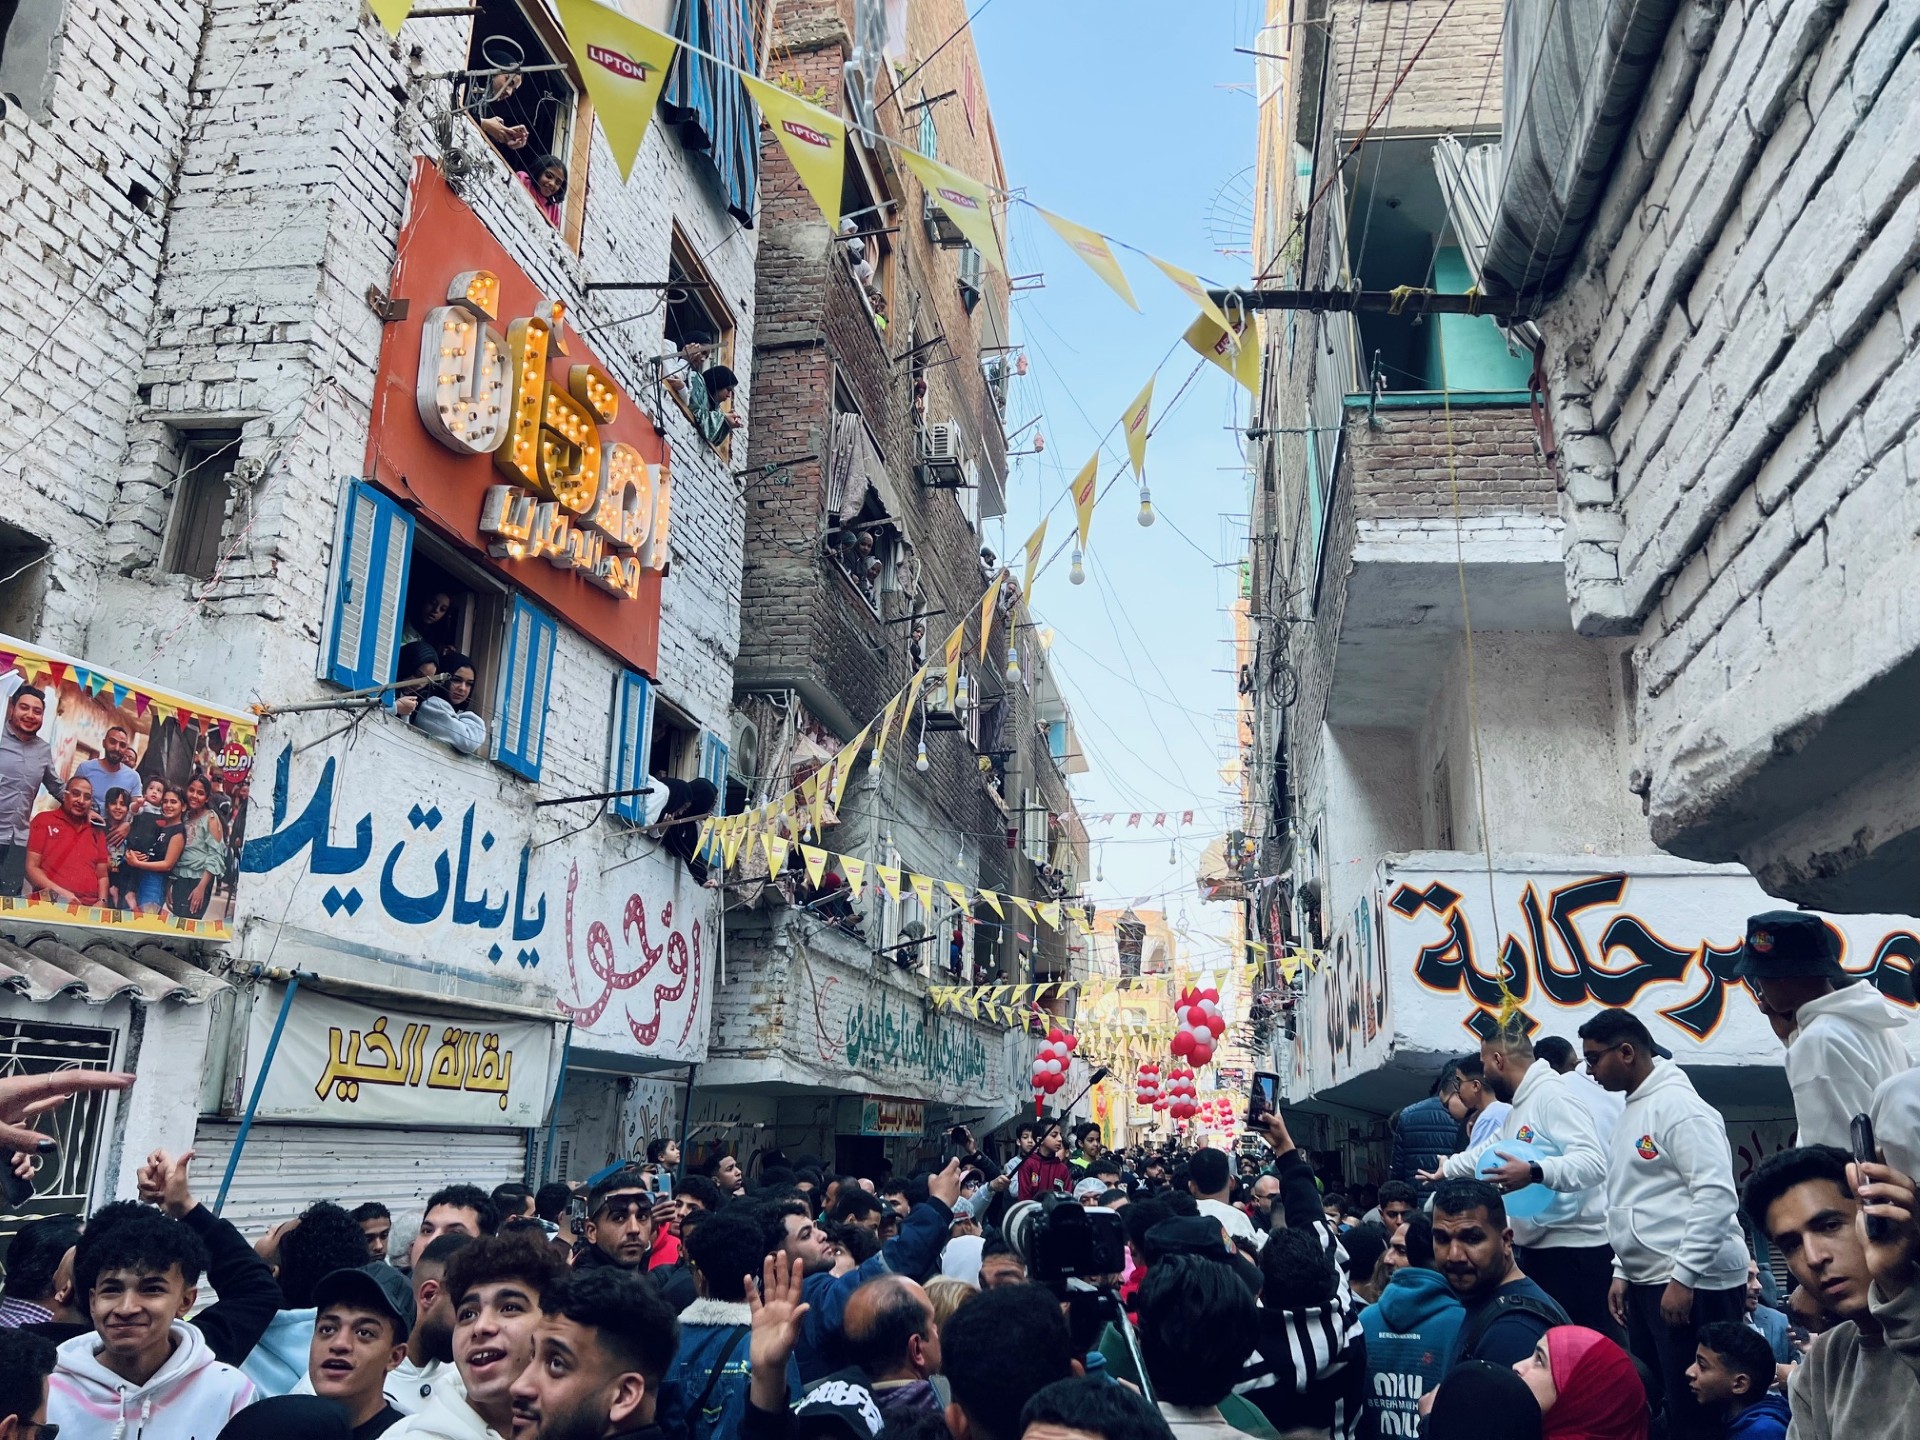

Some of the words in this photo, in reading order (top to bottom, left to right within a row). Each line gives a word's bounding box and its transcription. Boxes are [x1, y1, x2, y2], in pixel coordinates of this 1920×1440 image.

[588, 46, 646, 81] LIPTON
[783, 122, 831, 147] LIPTON
[938, 188, 979, 209] LIPTON
[241, 741, 373, 917] يلا
[315, 1015, 432, 1104] الخير
[426, 1027, 514, 1111] بقالة
